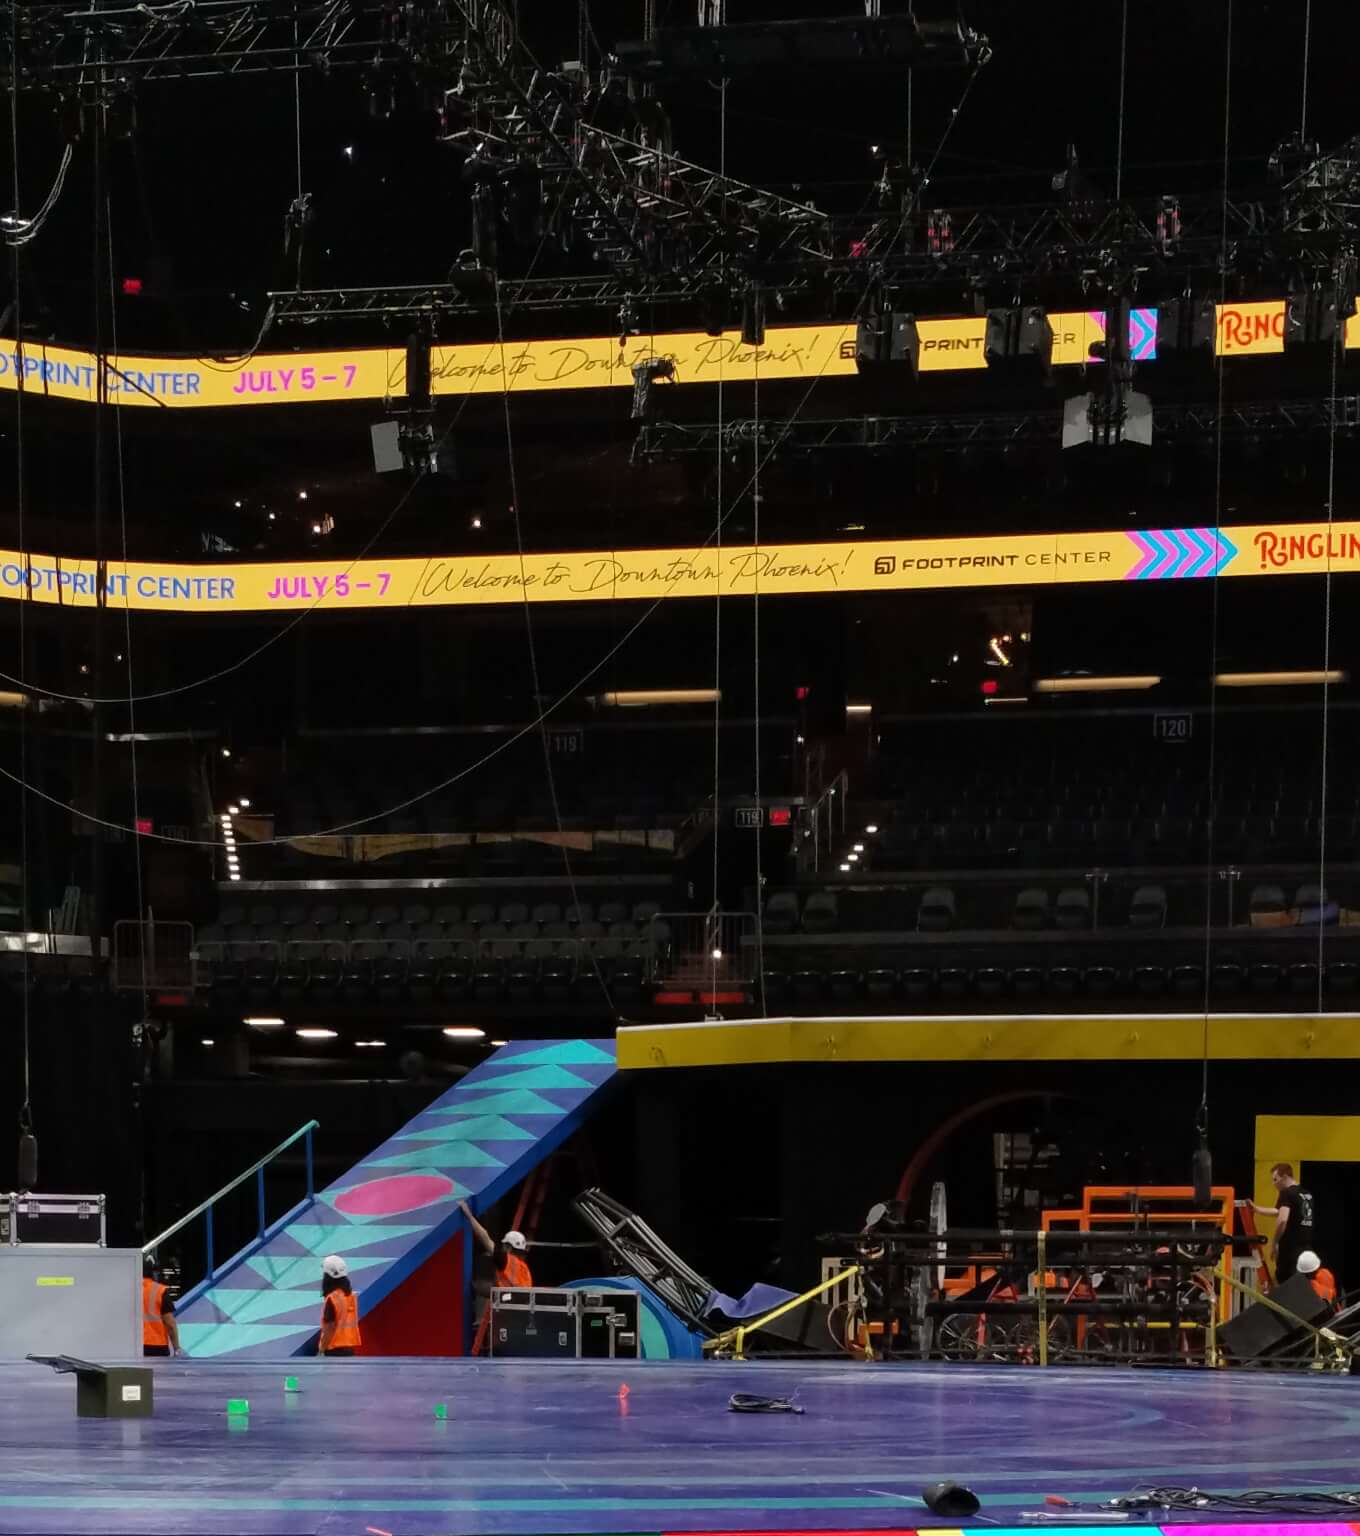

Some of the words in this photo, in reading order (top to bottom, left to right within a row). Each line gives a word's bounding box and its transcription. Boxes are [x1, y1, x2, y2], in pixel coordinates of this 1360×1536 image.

[509, 353, 536, 376] to
[693, 335, 814, 376] Phoenix!
[233, 369, 298, 394] JULY
[902, 554, 1018, 570] FOOTPRINT
[1025, 551, 1112, 566] CENTER
[422, 566, 542, 598] Welcome
[540, 564, 571, 586] to
[574, 562, 721, 592] Downtown
[730, 549, 853, 584] Phoenix!
[137, 575, 235, 599] CENTER
[267, 575, 333, 599] JULY
[1160, 719, 1186, 737] 120
